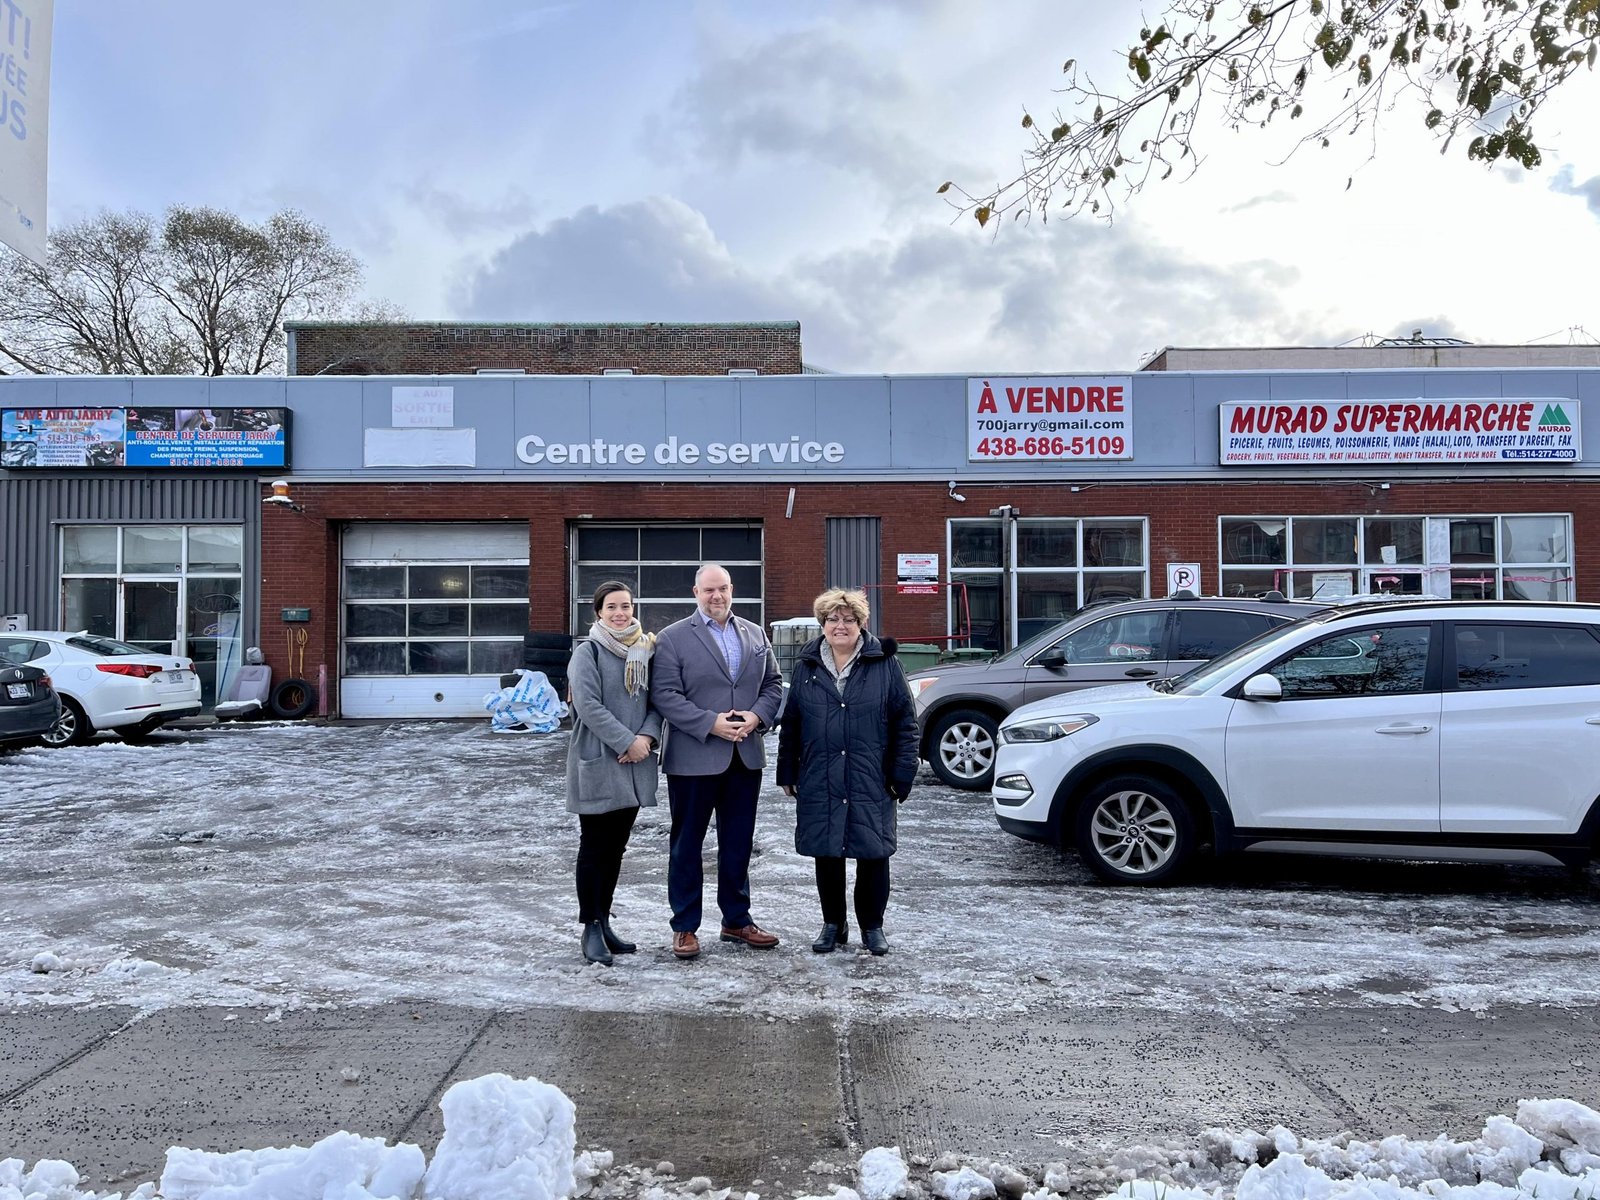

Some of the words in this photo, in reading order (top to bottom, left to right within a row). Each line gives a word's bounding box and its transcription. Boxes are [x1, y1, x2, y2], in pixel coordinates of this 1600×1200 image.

[976, 381, 998, 414] À
[1005, 386, 1124, 414] VENDRE
[16, 409, 43, 420] LAVE
[45, 409, 74, 420] AUTO
[77, 409, 113, 420] JARRY
[394, 402, 452, 413] SORTIE
[410, 416, 434, 424] EXIT
[976, 418, 1125, 433] 700jarry@gmail.com
[1230, 405, 1328, 435] MURAD
[135, 431, 178, 440] CENTRE
[180, 431, 194, 440] DE
[198, 431, 242, 440] SERVICE
[245, 431, 277, 440] JARRY
[1229, 437, 1265, 450] EPICERIE,
[1267, 437, 1295, 450] FRUITS,
[1297, 437, 1332, 449] LEGUMES,
[1335, 436, 1390, 449] POISSONNERIE,
[1393, 436, 1420, 448] VIANDE
[1476, 435, 1517, 447] TRANSFERT
[1519, 435, 1555, 447] D'ARGENT,
[1558, 435, 1572, 446] FAX
[516, 434, 646, 464] Centre
[654, 436, 700, 464] de
[707, 435, 845, 464] service
[976, 436, 1125, 456] 438-686-5109
[1226, 452, 1252, 461] GROCERY,
[1254, 452, 1275, 461] FRUITS,
[1277, 452, 1310, 461] VEGETABLES,
[1329, 452, 1344, 460] MEAT
[1394, 451, 1413, 460] MONEY
[1446, 451, 1456, 459] FAX
[1457, 451, 1462, 459] &
[1463, 451, 1480, 459] MUCH
[1481, 451, 1497, 459] MORE
